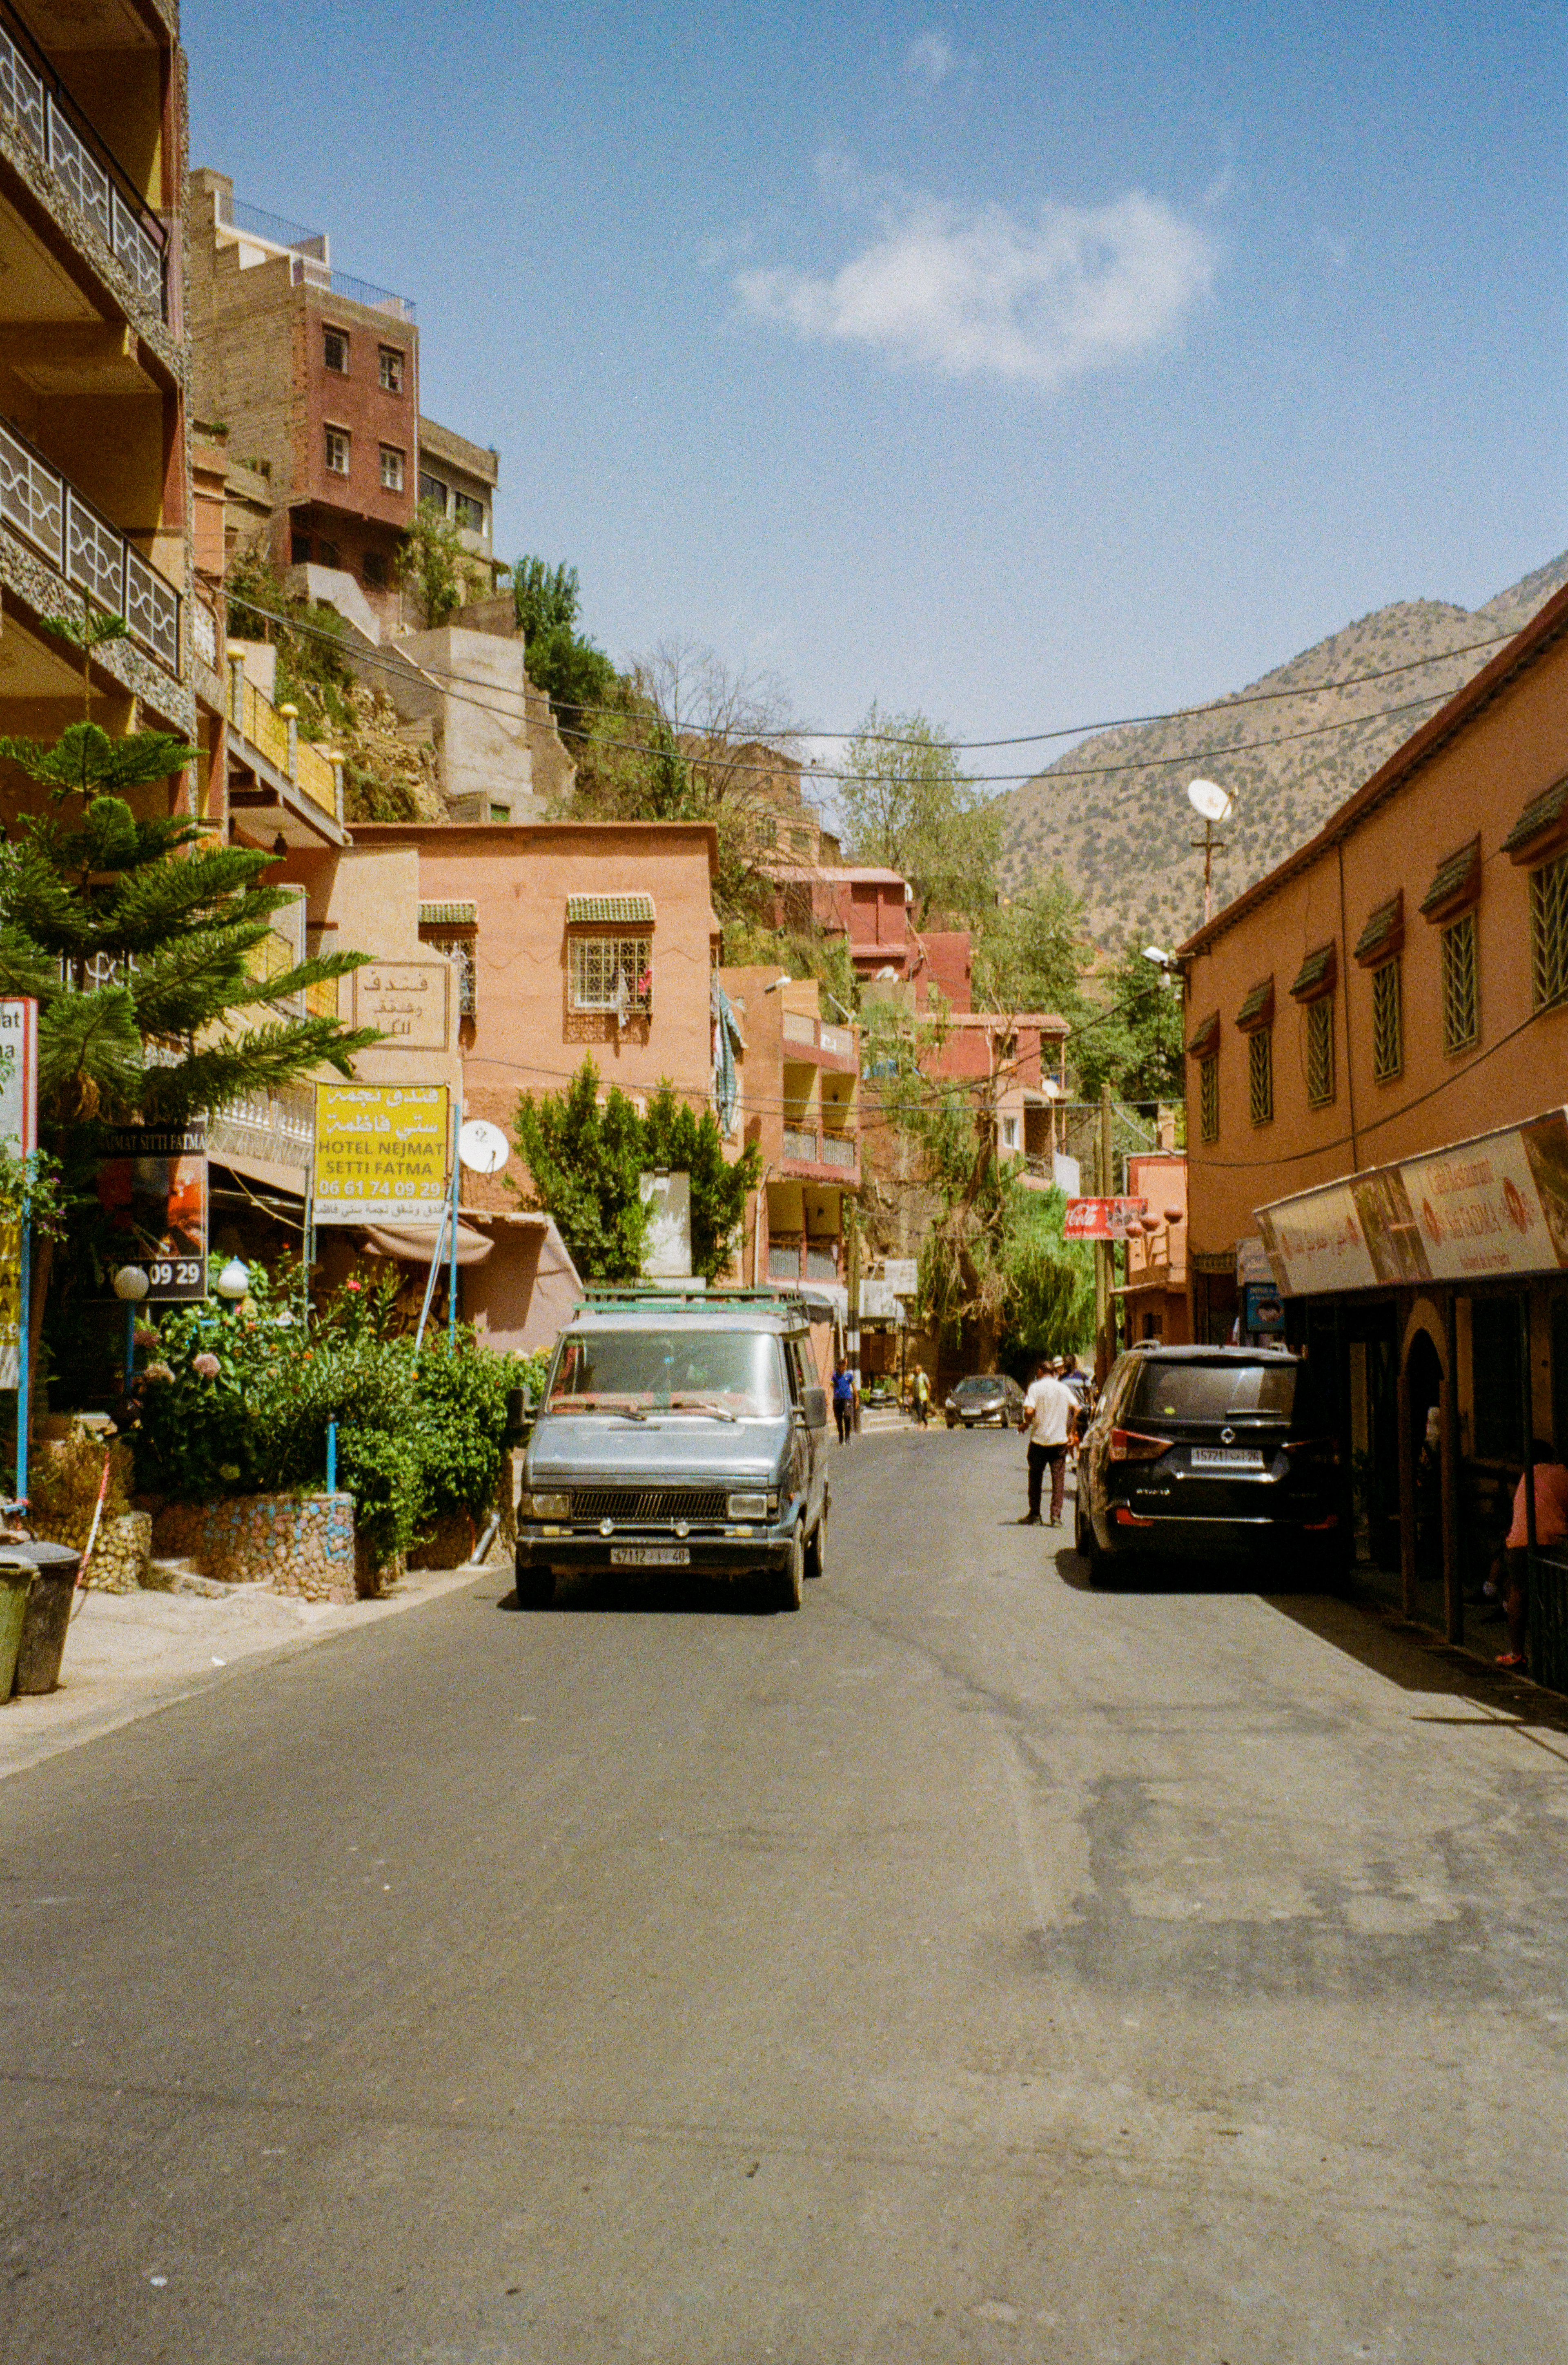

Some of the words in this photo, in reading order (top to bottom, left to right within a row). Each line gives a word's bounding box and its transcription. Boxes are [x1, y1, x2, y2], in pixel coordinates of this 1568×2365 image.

[318, 1141, 372, 1155] HOTEL
[378, 1142, 444, 1158] NEJMAT
[326, 1161, 369, 1175] SETTI
[375, 1162, 432, 1175] FATMA
[319, 1180, 339, 1195] 06
[344, 1180, 363, 1195] 61
[370, 1181, 389, 1196] 74
[394, 1182, 415, 1197] 09
[419, 1182, 440, 1197] 29
[151, 1263, 172, 1285] 09
[176, 1263, 200, 1284] 29
